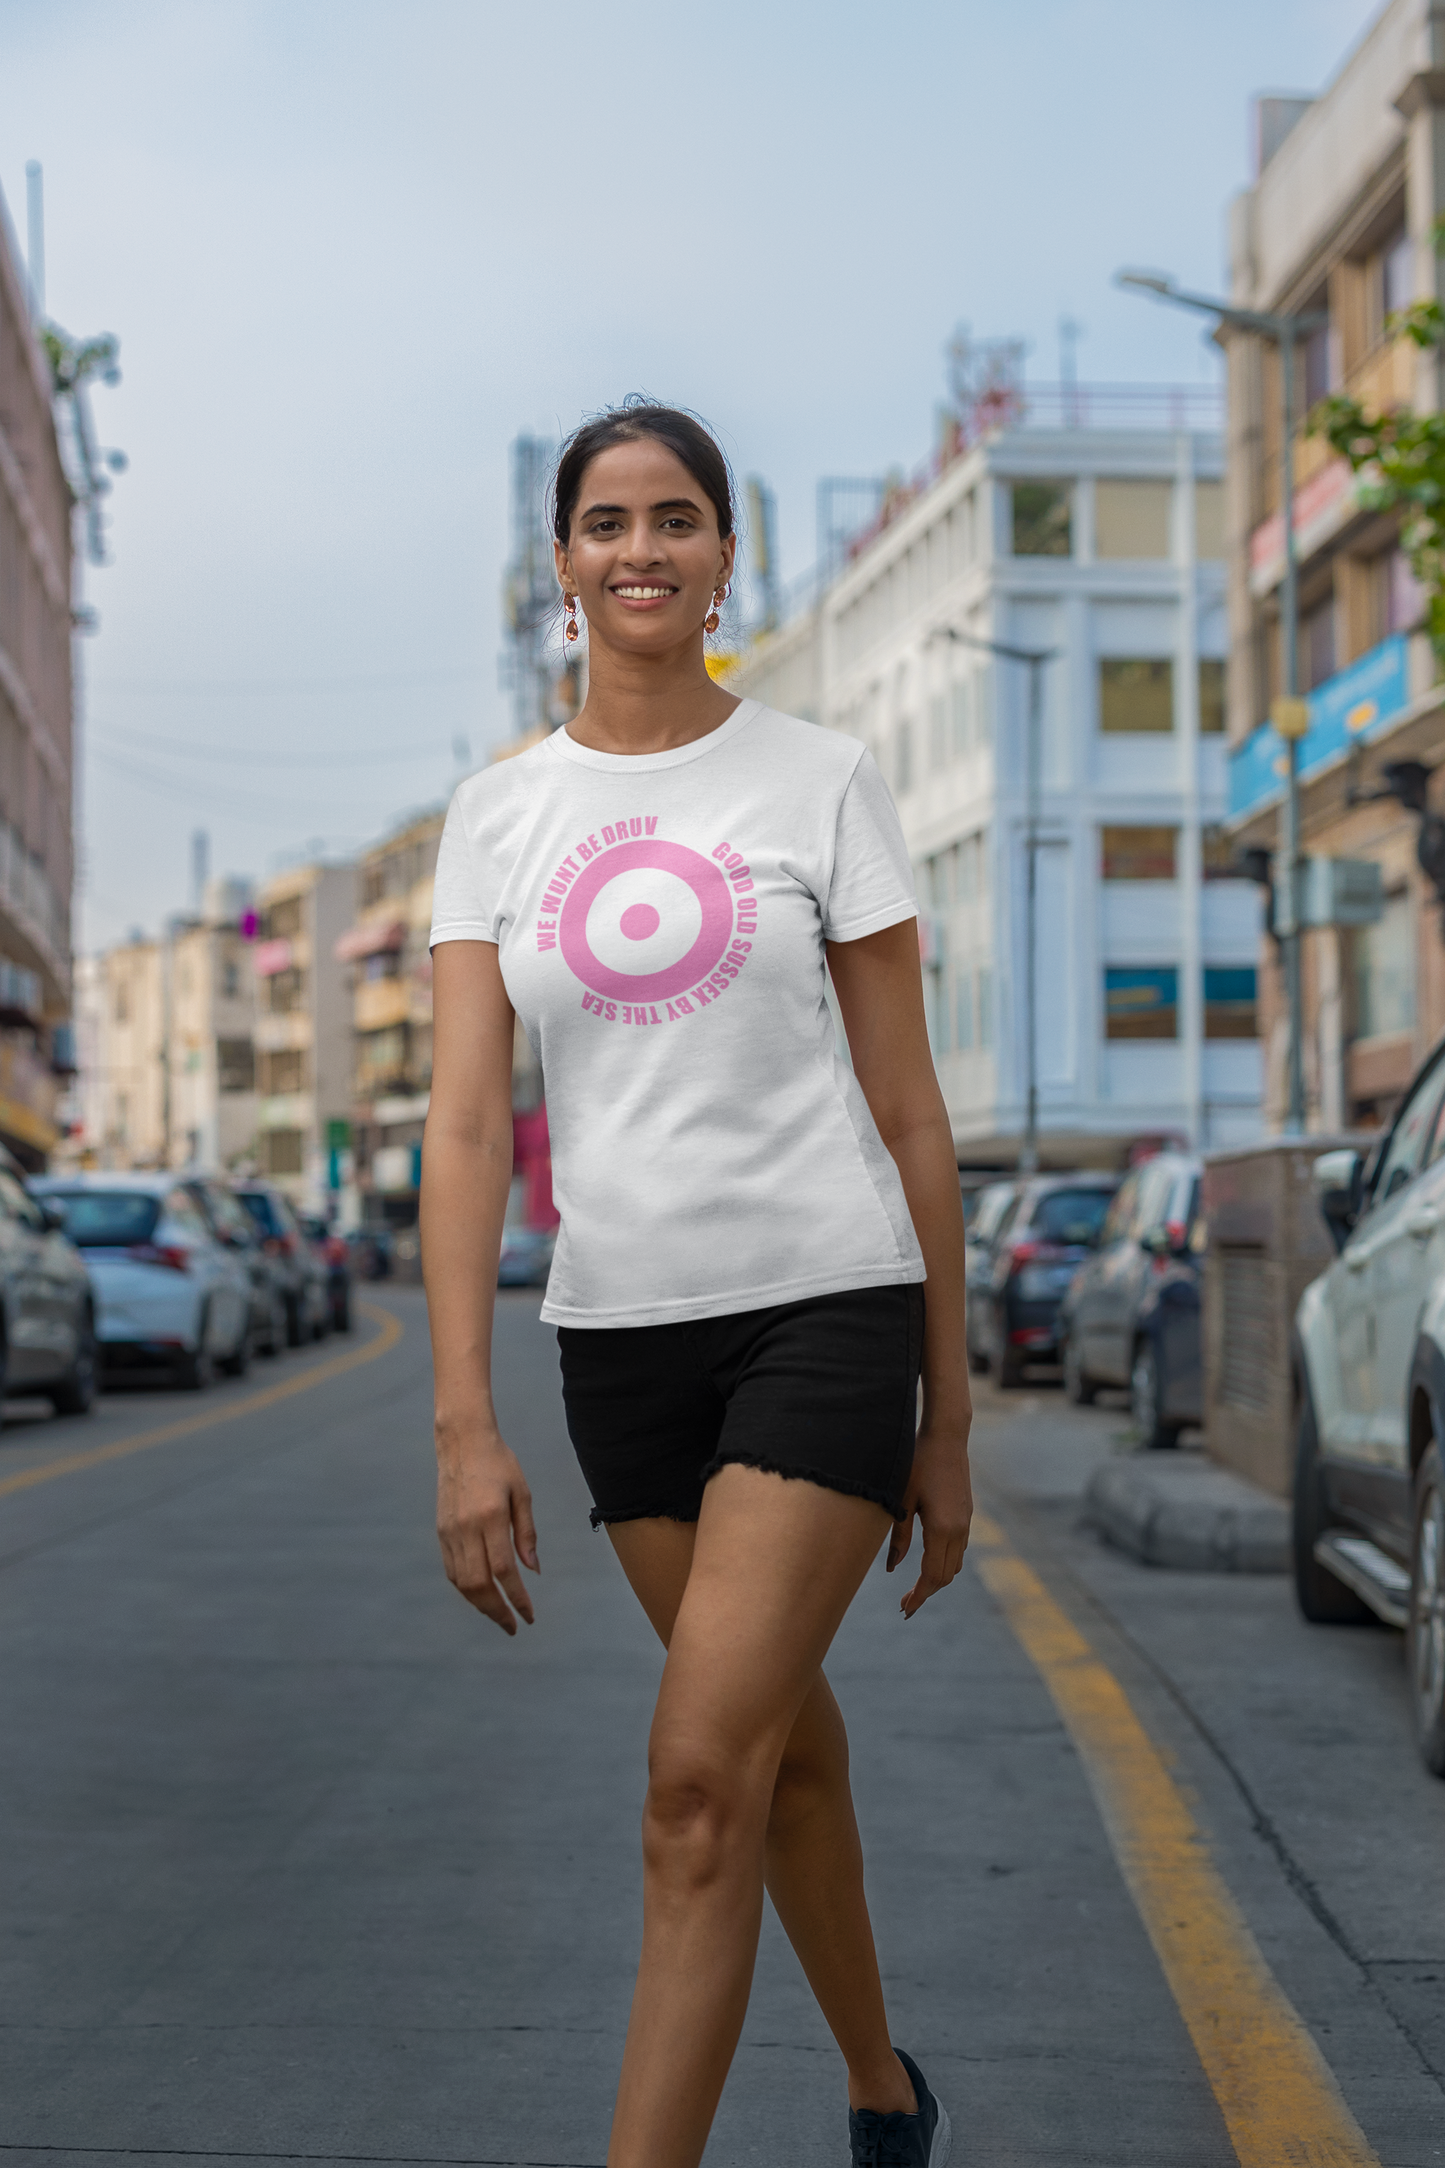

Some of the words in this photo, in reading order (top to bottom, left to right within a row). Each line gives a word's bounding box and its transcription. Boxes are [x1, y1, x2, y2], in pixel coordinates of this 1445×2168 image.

[600, 815, 659, 846] DRUV
[575, 833, 603, 862] BE
[711, 841, 755, 894] GOOD
[539, 854, 581, 915] WUNT
[736, 897, 758, 934] OLD
[536, 920, 557, 953] WE
[689, 938, 753, 1007] SUSSEX
[580, 990, 618, 1021] SEA
[622, 1005, 663, 1026] THE
[665, 995, 696, 1022] BY
